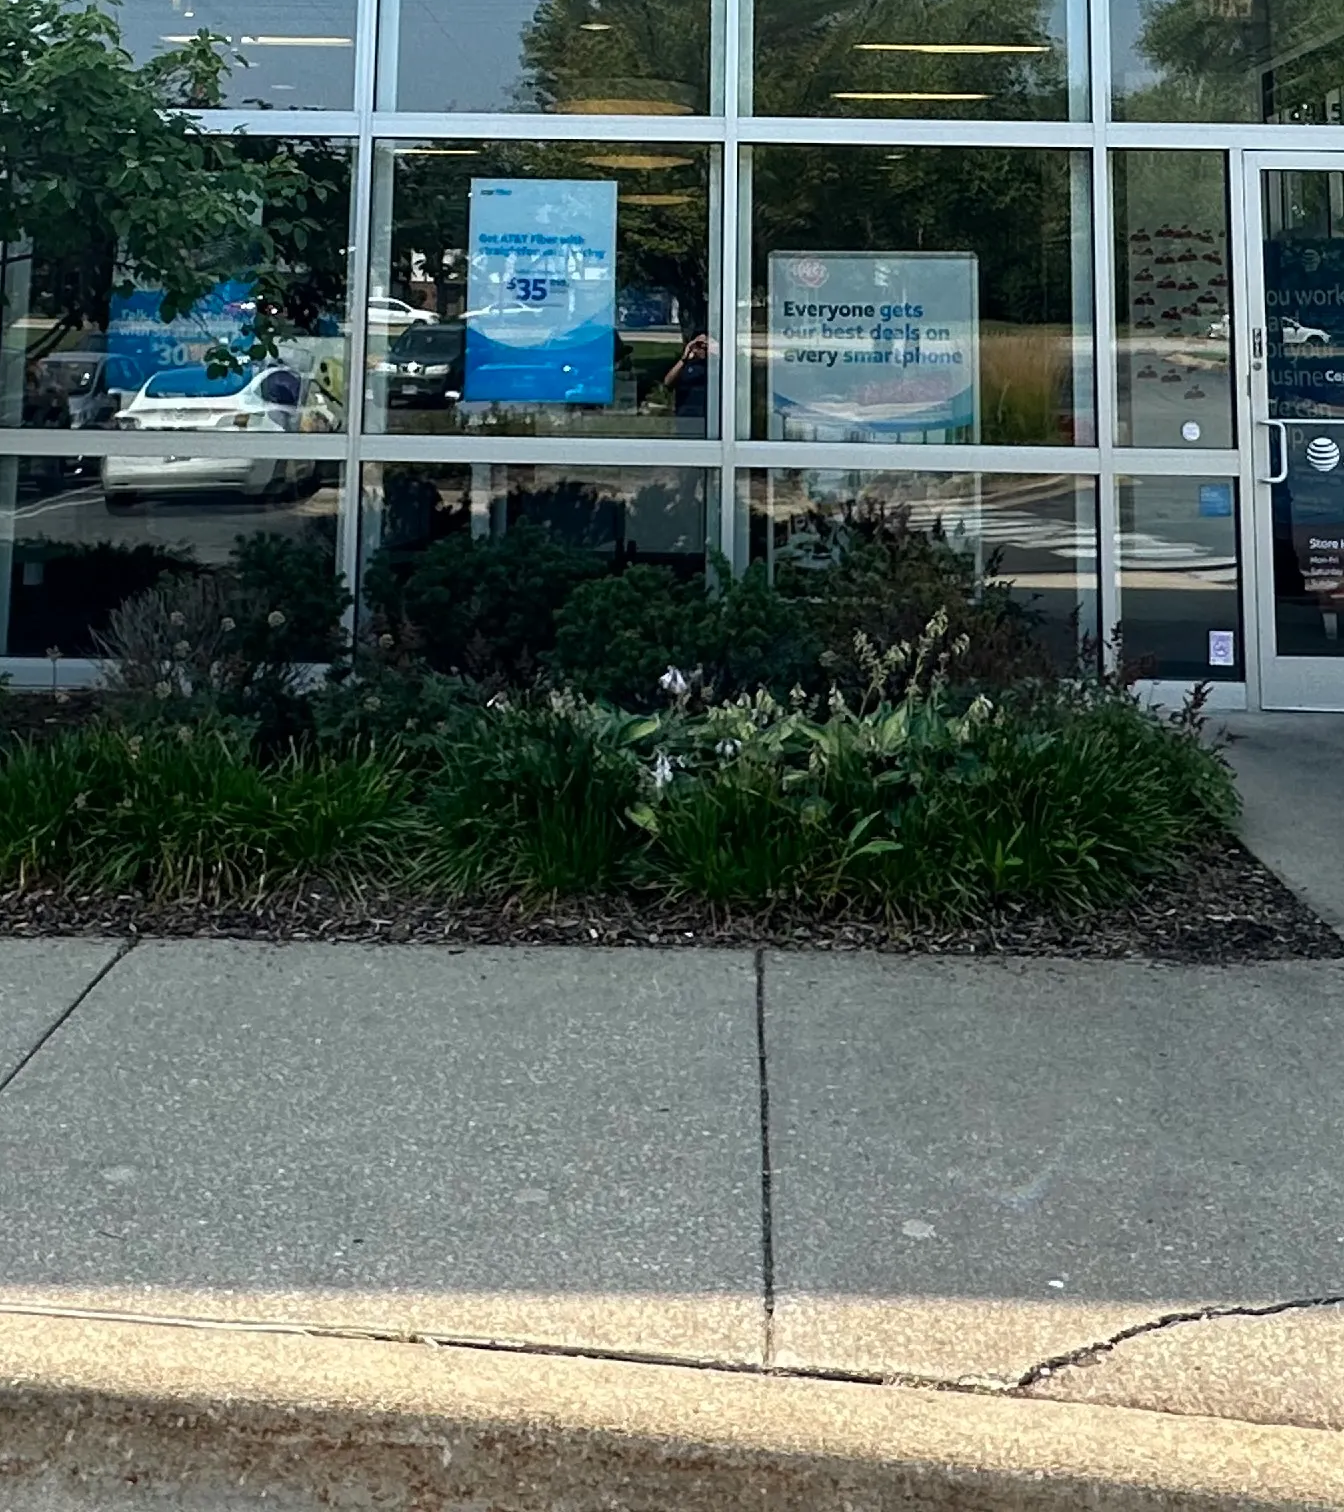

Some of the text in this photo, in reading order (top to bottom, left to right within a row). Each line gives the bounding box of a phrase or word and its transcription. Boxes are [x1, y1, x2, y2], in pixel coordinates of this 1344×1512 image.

[506, 276, 549, 302] $35
[1265, 289, 1291, 307] ou
[783, 300, 925, 322] Everyone gets
[782, 323, 951, 340] our best deals on
[783, 346, 963, 369] every smartphone
[1309, 537, 1338, 550] Store
